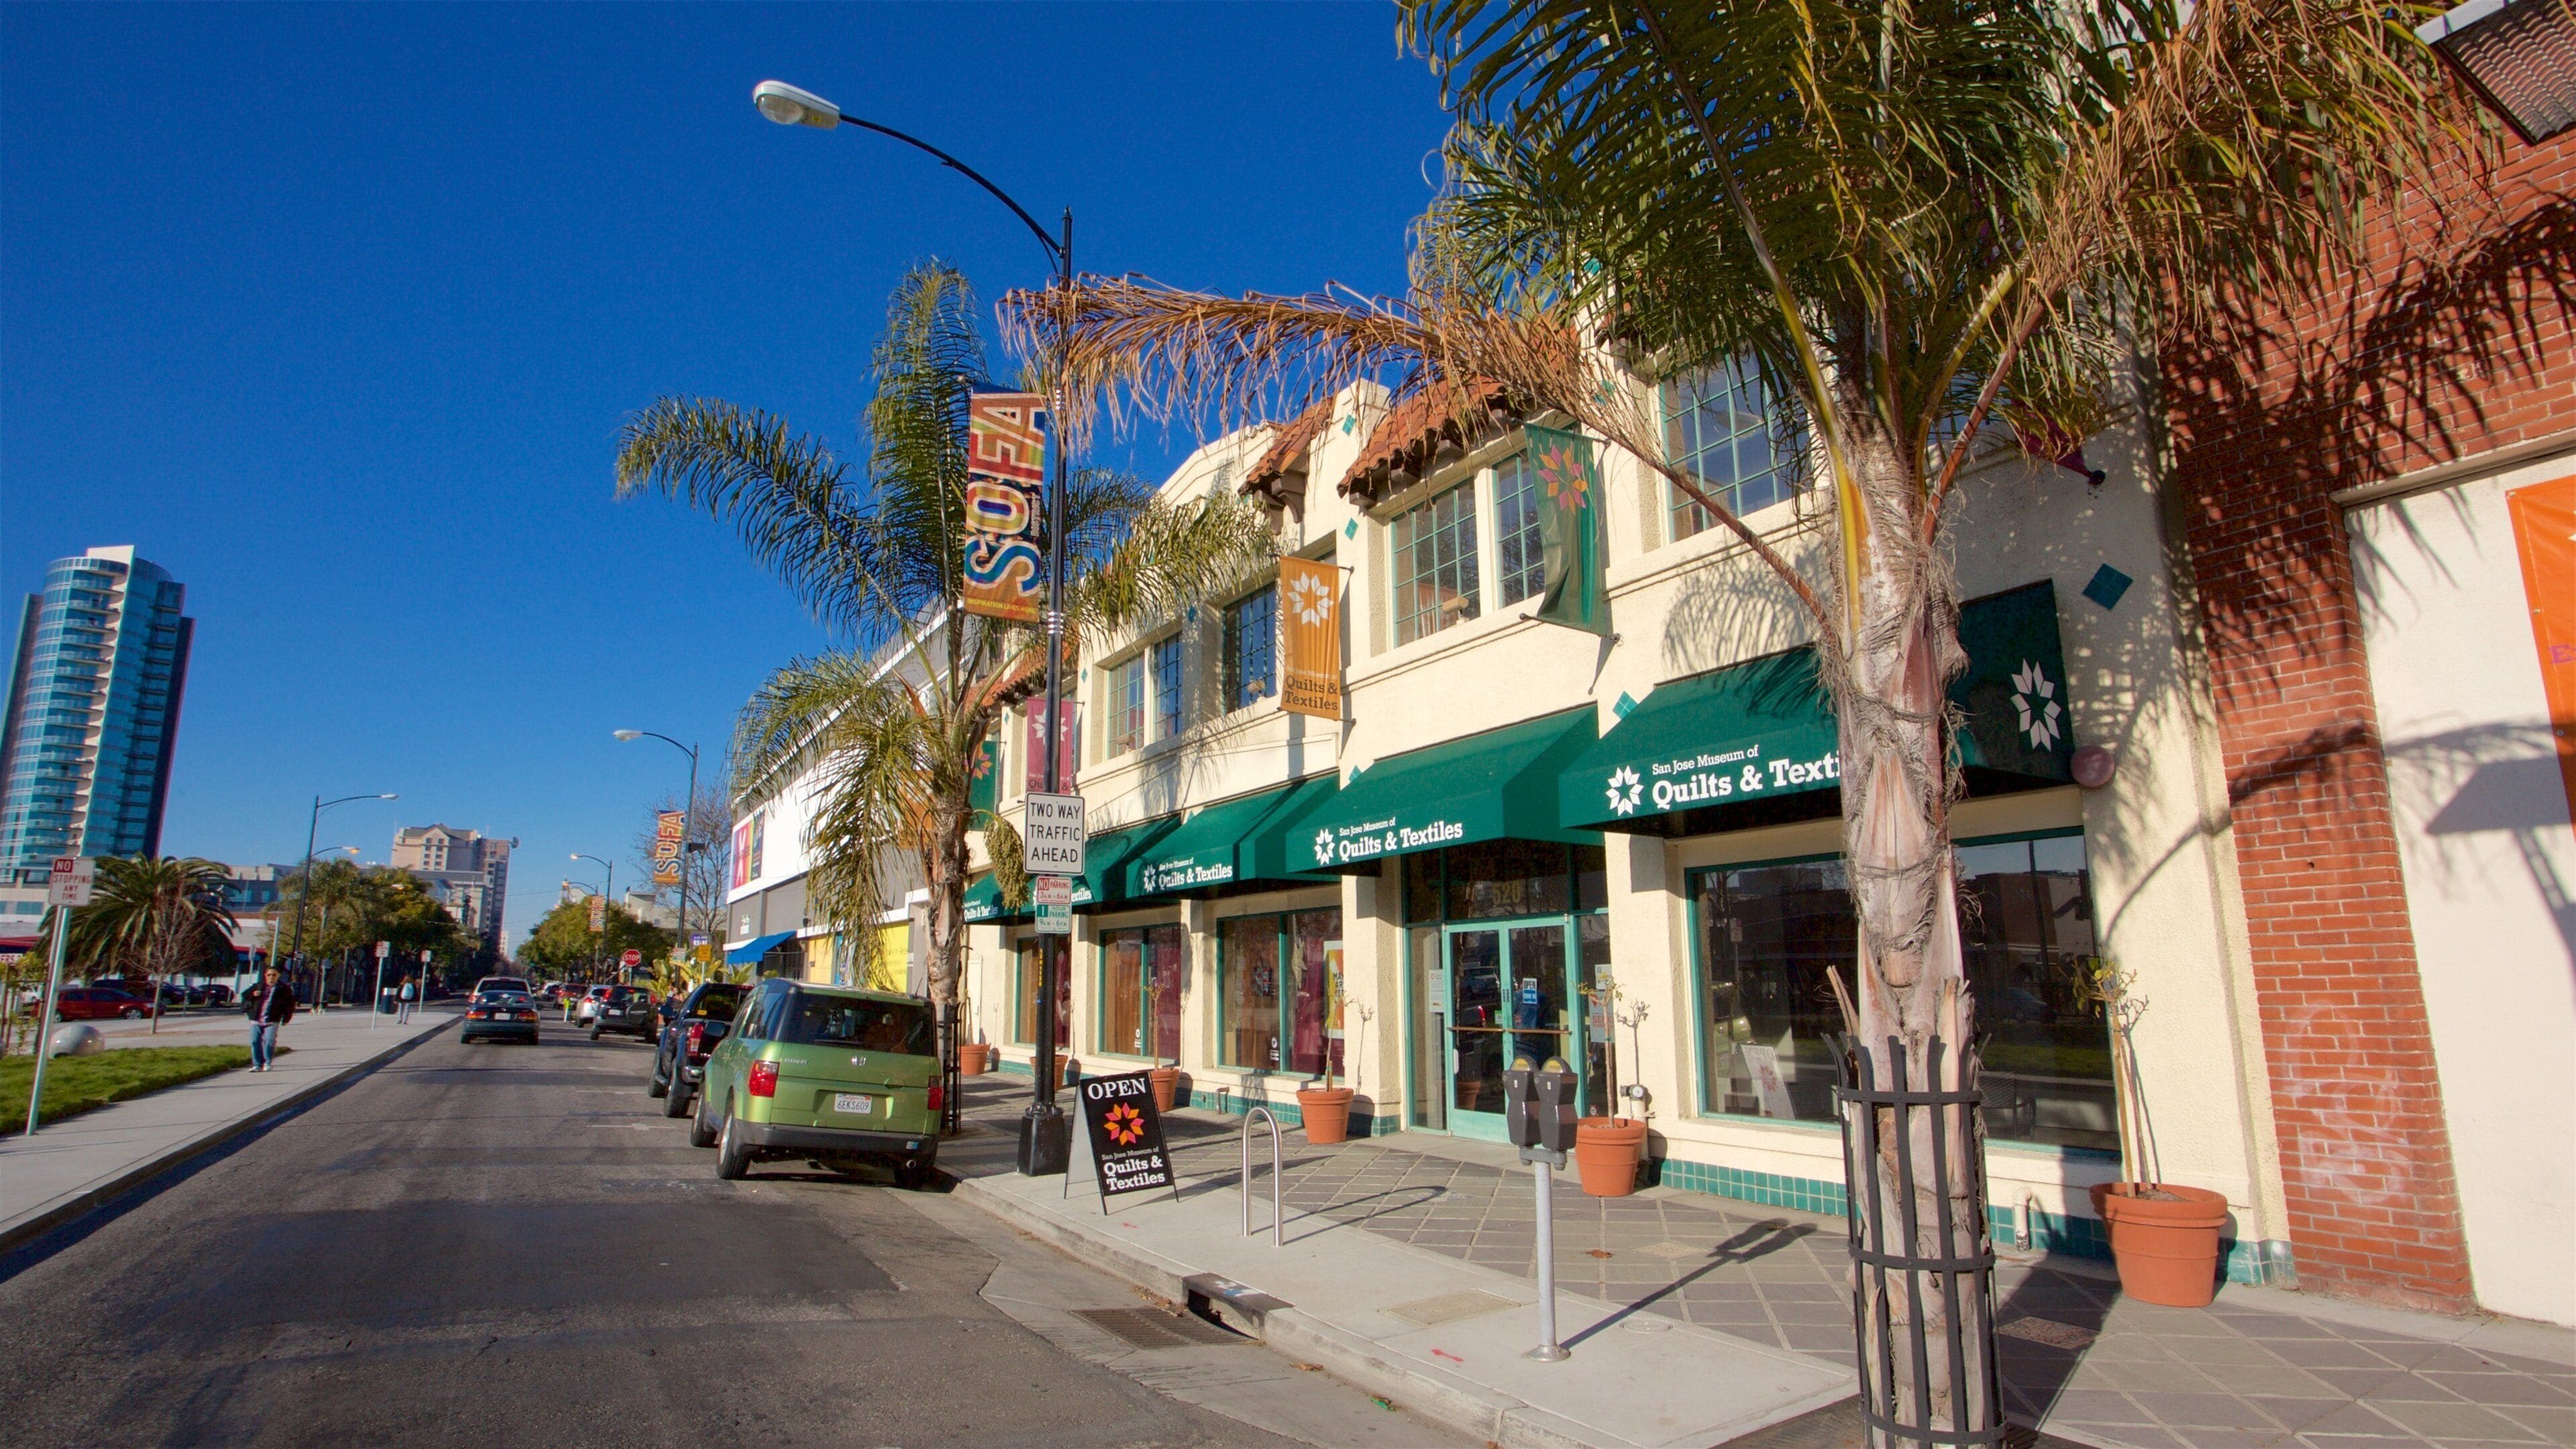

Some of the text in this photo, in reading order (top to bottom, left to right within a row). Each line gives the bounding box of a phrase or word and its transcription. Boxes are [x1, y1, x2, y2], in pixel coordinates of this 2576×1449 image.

[964, 392, 1045, 597] SOFA
[1031, 494, 1042, 537] DISTRICT
[967, 598, 1004, 609] INSPIRATION
[1286, 675, 1338, 695] Quilts &
[1284, 690, 1338, 710] Textiles
[1652, 745, 1759, 775] San Jose Museum of
[1061, 782, 1069, 791] &
[1652, 773, 1732, 810] Quilts
[1739, 765, 1764, 792] &
[1030, 802, 1081, 819] TWO WAY
[1030, 824, 1080, 841] TRAFFIC
[1339, 817, 1396, 837] San Jose Museum of
[655, 812, 685, 875] SOFA
[1339, 820, 1463, 862] Quilts & Textiles
[1031, 846, 1078, 863] AHEAD
[55, 860, 72, 871] NO
[54, 874, 91, 883] STOPPING
[1038, 878, 1069, 890] NO PARKING
[1159, 863, 1232, 891] Quilts & Textiles
[1071, 888, 1092, 902] extiles
[1523, 980, 1536, 989] OPEN
[1087, 1077, 1147, 1100] OPEN
[837, 1100, 869, 1111] 6EKS609
[1114, 1151, 1127, 1161] Jose
[1127, 1148, 1152, 1157] Museum
[1104, 1155, 1163, 1177] Quilts &
[1107, 1172, 1166, 1191] Textiles
